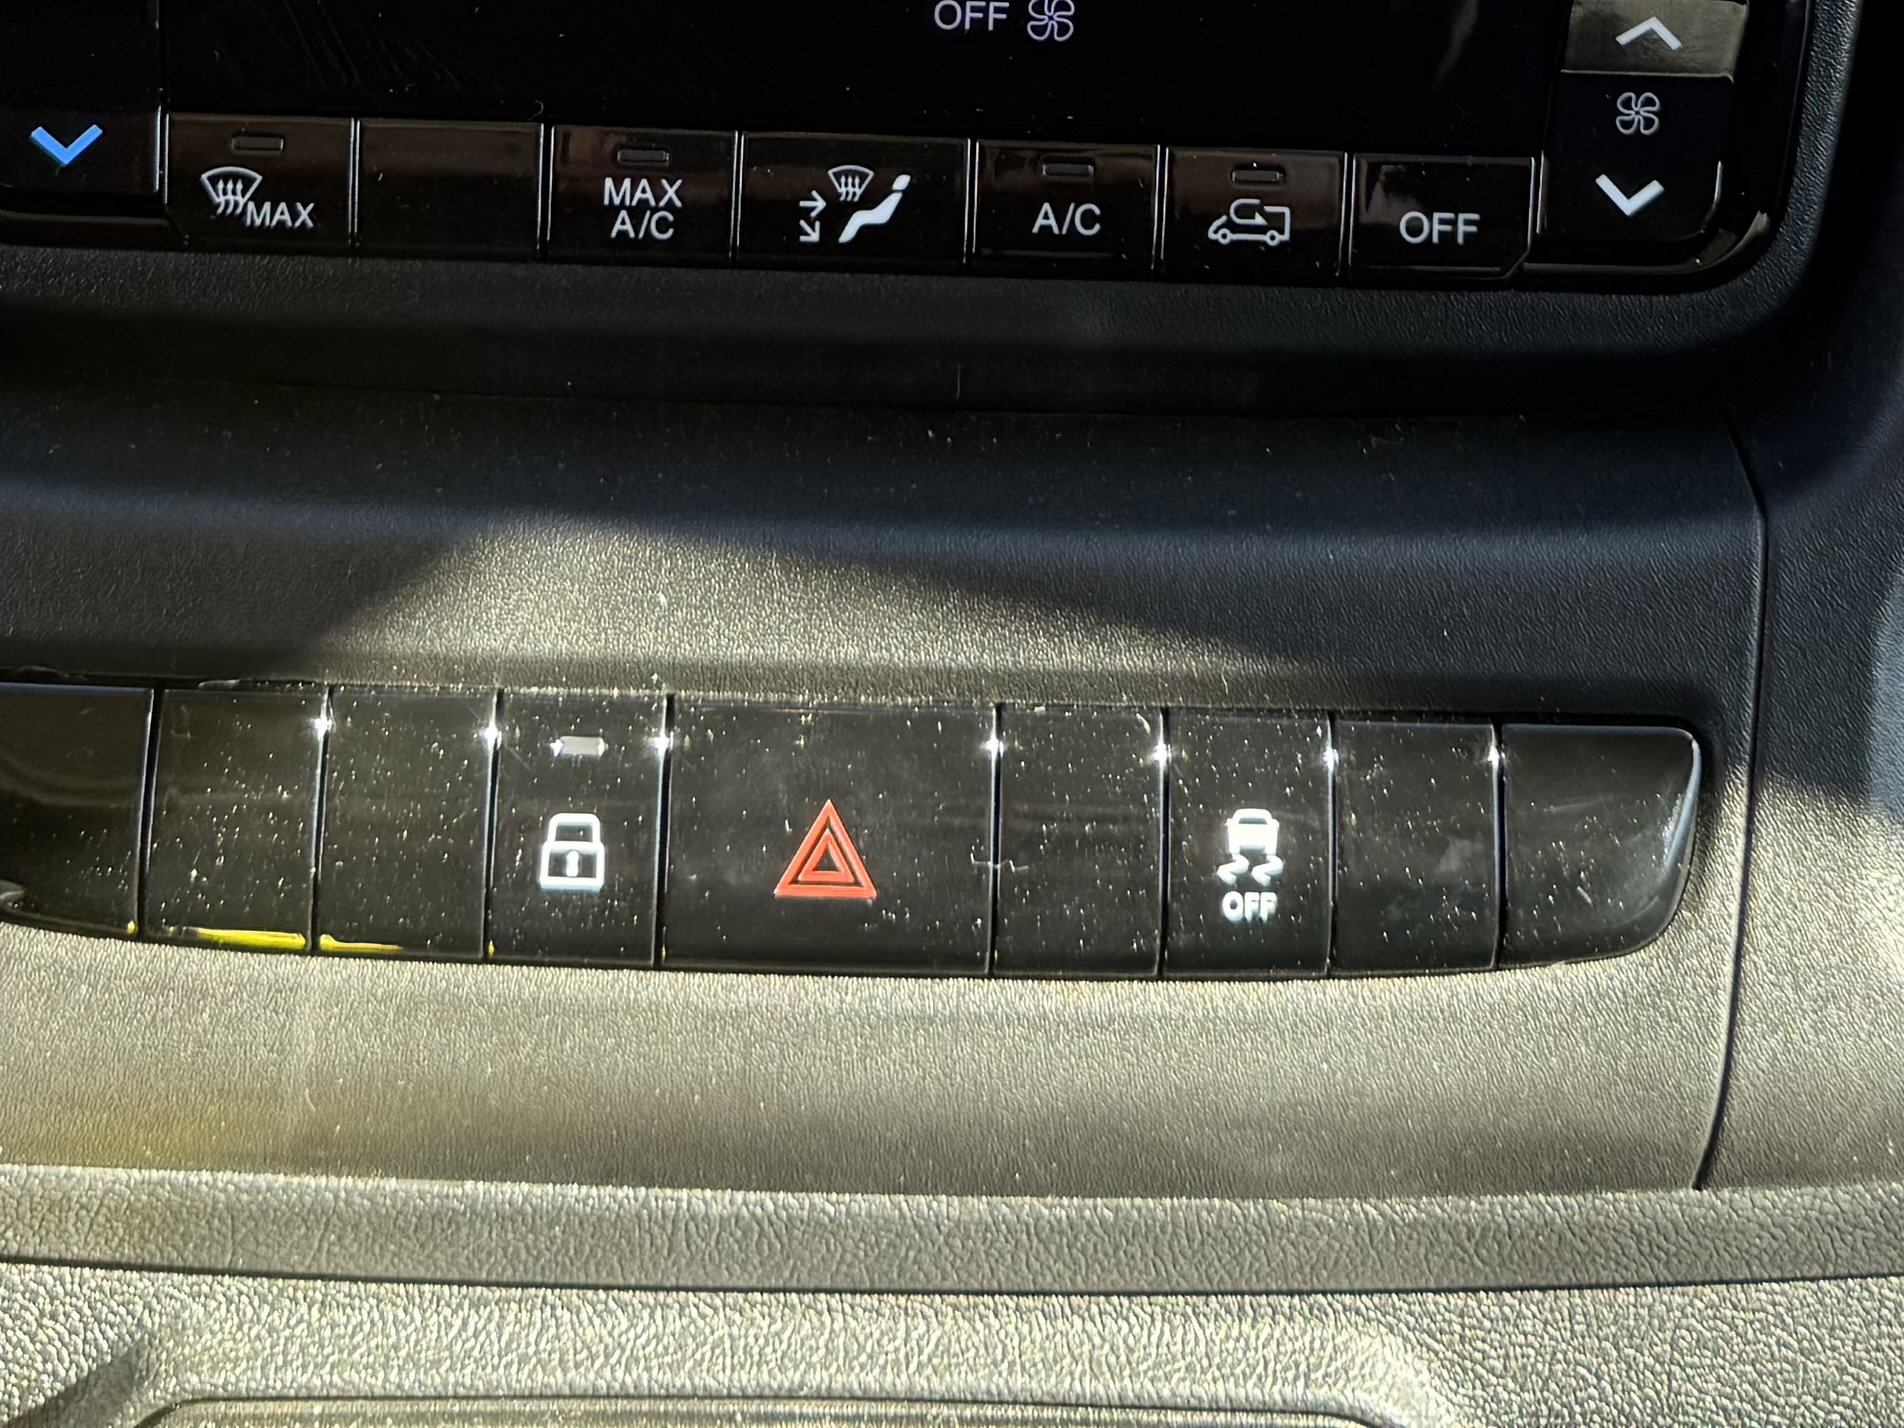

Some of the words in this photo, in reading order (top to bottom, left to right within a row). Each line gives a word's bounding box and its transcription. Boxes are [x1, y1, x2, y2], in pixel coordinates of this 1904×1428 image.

[933, 0, 1009, 32] OFF
[602, 179, 683, 208] MAX
[245, 201, 316, 229] MAX
[611, 212, 675, 240] A/C
[1031, 203, 1101, 237] A/C
[1399, 211, 1480, 245] OFF
[1222, 891, 1278, 922] OFF
